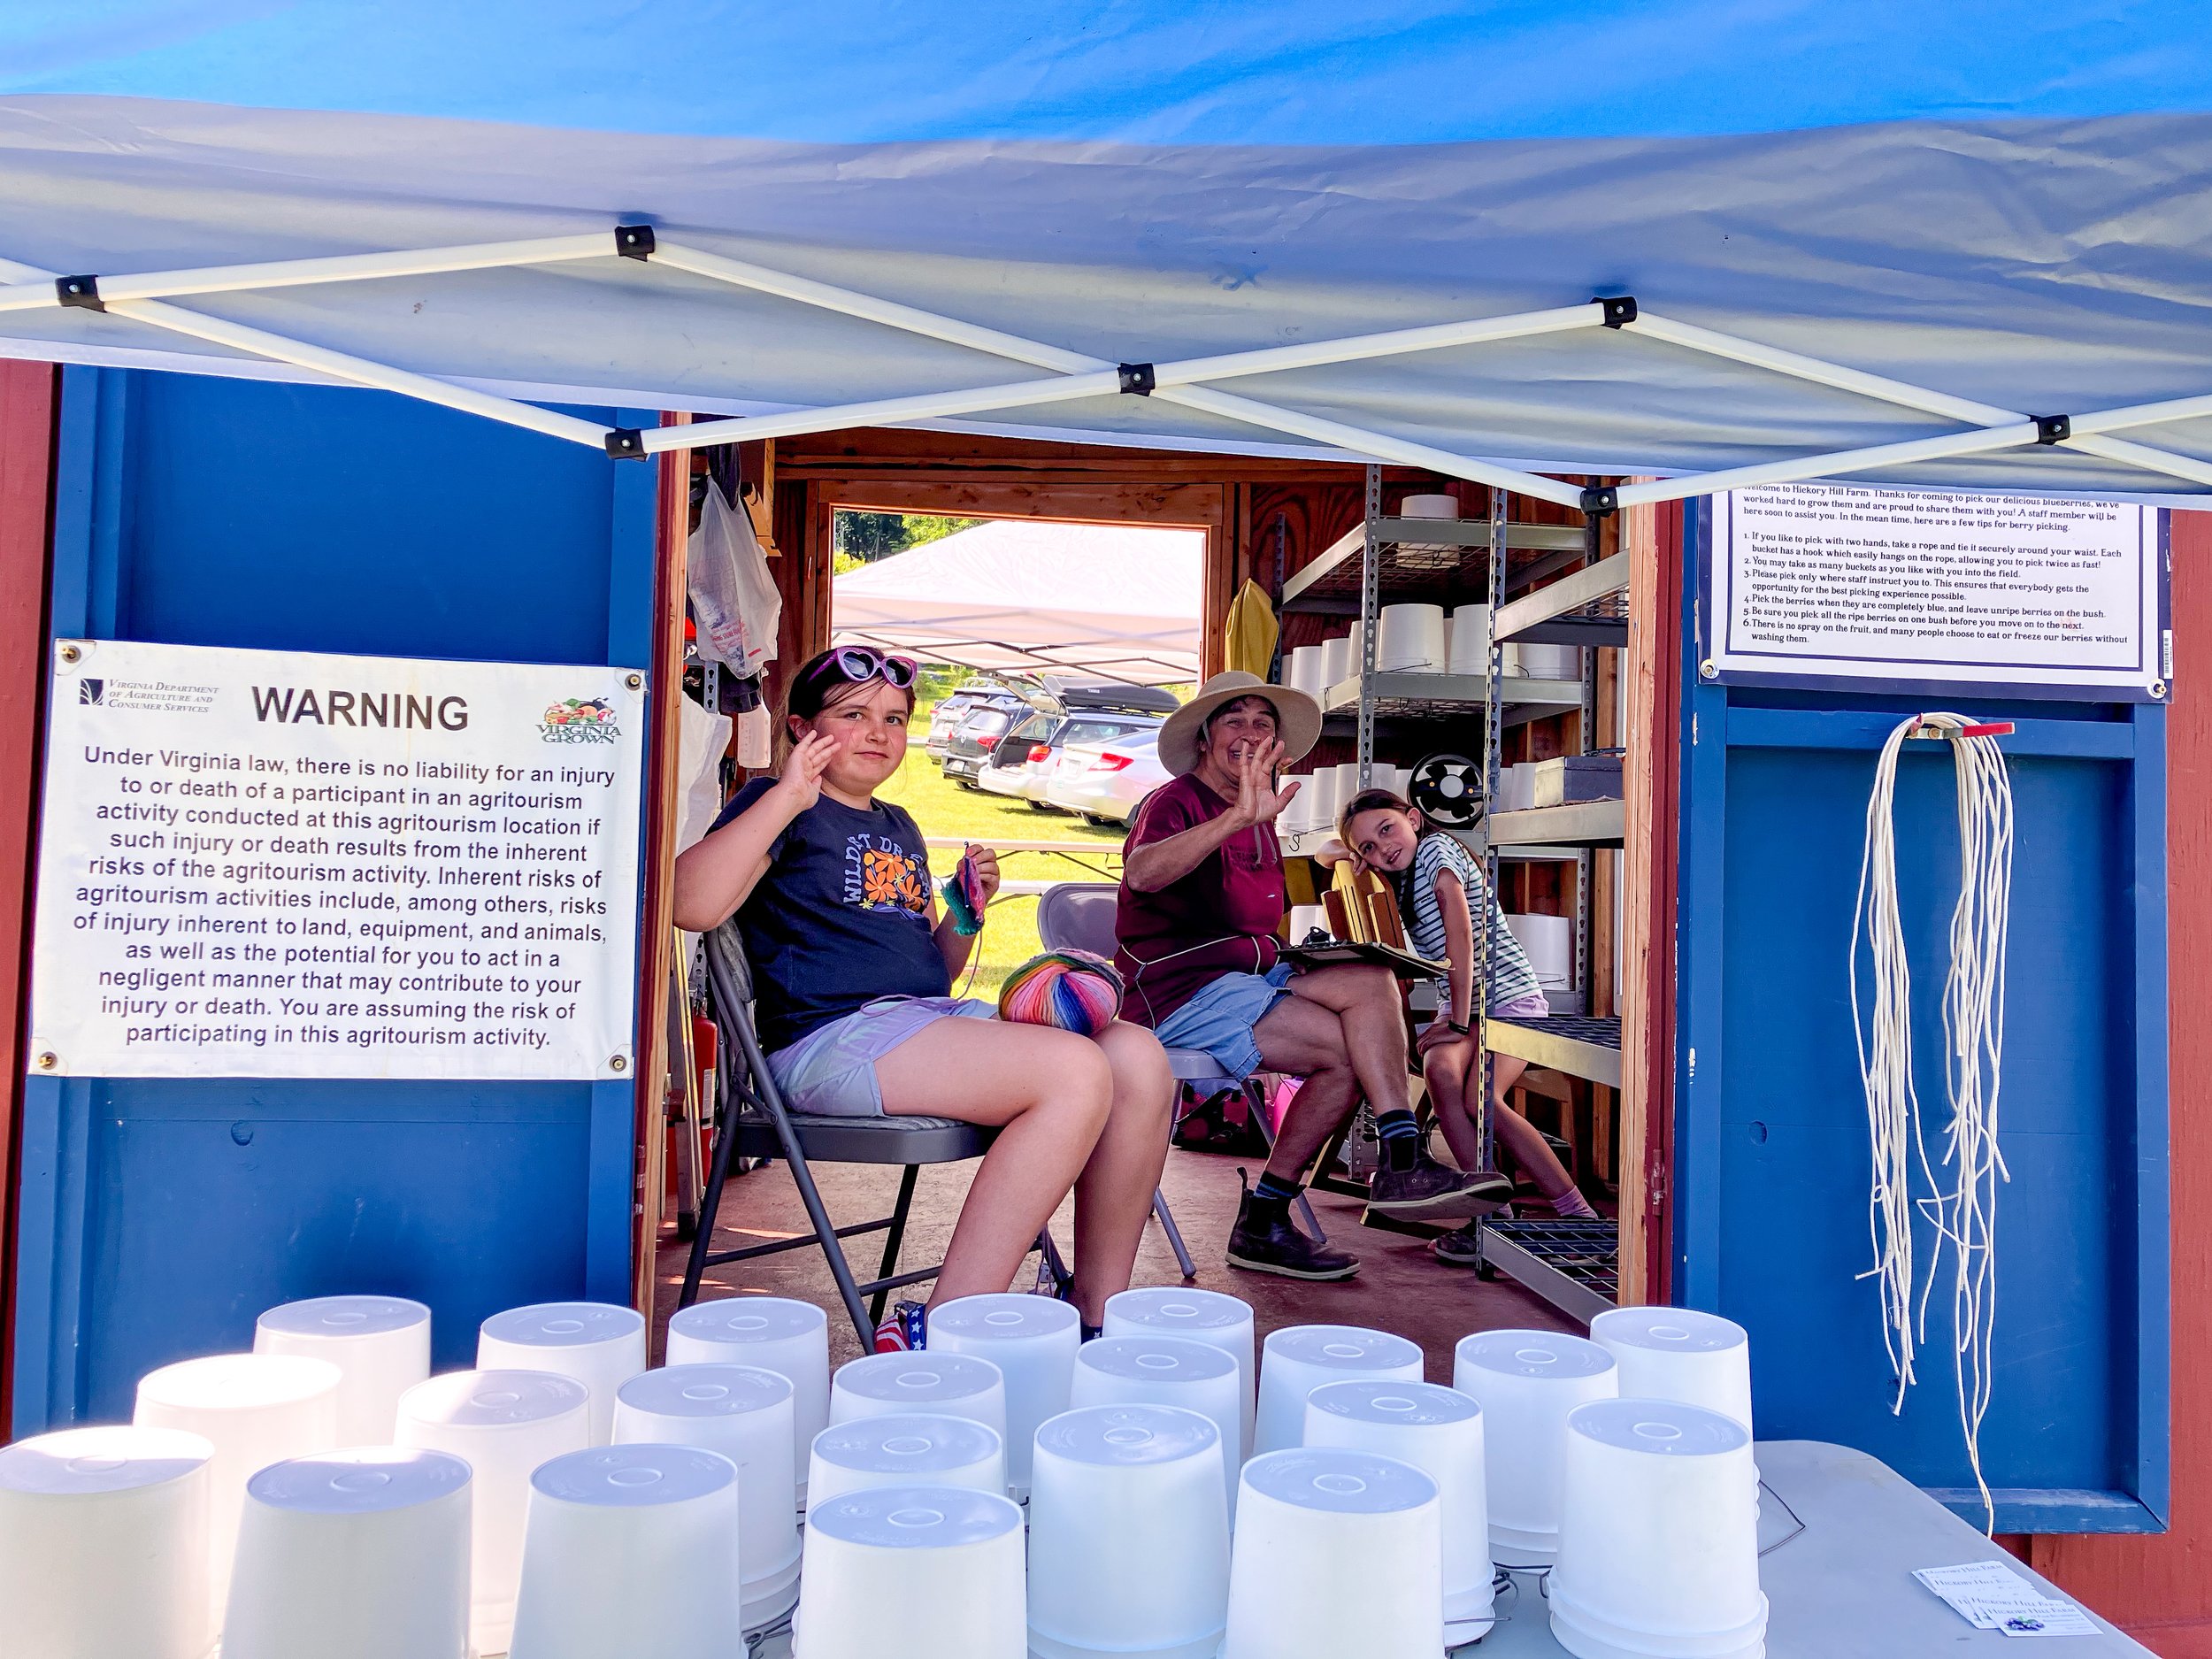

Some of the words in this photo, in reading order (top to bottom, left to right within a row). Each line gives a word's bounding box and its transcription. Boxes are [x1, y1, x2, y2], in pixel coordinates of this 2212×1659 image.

[1743, 506, 1763, 516] here
[1794, 511, 1817, 519] assist
[1839, 511, 1848, 520] In
[1850, 513, 1863, 522] the
[1891, 515, 1912, 525] time,
[1914, 516, 1934, 526] here
[1977, 519, 1993, 529] tips
[2009, 520, 2034, 532] berry
[2036, 522, 2070, 534] picking.
[1752, 556, 1768, 566] You
[1770, 559, 1787, 569] may
[1788, 559, 1807, 568] take
[1819, 563, 1844, 572] many
[1845, 562, 1877, 572] buckets
[1888, 566, 1906, 575] you
[1908, 565, 1924, 574] like
[1925, 566, 1945, 575] with
[1964, 568, 1982, 577] into
[1999, 569, 2021, 578] field.
[1752, 583, 1800, 595] opportunity
[1801, 585, 1814, 594] for
[1816, 586, 1830, 595] the
[1831, 586, 1847, 595] best
[1849, 588, 1880, 599] picking
[1882, 590, 1930, 599] experience
[1931, 592, 1967, 601] possible.
[1751, 633, 1785, 644] washing
[1786, 634, 1809, 643] them.
[109, 679, 153, 690] VIRGINIA
[156, 681, 219, 694] DEPARTMENT
[125, 690, 191, 702] AGRICULTURE
[108, 698, 162, 710] CONSUMER
[164, 703, 209, 713] SERVICES
[250, 685, 469, 732] WARNING
[535, 724, 622, 736] VIRGINIA
[541, 734, 615, 744] GROWN
[84, 745, 155, 766] Under
[158, 749, 242, 773] Virginia
[248, 754, 289, 776] law,
[296, 757, 351, 775] there
[358, 758, 376, 776] is
[383, 764, 409, 778] no
[416, 760, 490, 785] liability
[495, 764, 526, 781] for
[530, 769, 554, 782] an
[560, 765, 616, 788] injury
[119, 776, 142, 794] to
[149, 780, 173, 795] or
[179, 779, 238, 798] death
[245, 781, 268, 799] of
[273, 787, 285, 800] a
[292, 785, 406, 807] participant
[411, 787, 430, 805] in
[436, 792, 462, 806] an
[468, 790, 583, 811] agritourism
[96, 802, 180, 827] activity
[185, 807, 299, 827] conducted
[305, 810, 326, 828] at
[332, 810, 373, 829] this
[377, 813, 496, 835] agritourism
[503, 816, 581, 835] location
[588, 818, 602, 836] if
[109, 830, 165, 849] such
[173, 831, 234, 856] injury
[240, 838, 265, 853] or
[269, 835, 329, 855] death
[336, 838, 407, 857] results
[413, 839, 461, 859] from
[467, 841, 499, 860] the
[505, 842, 588, 862] inherent
[88, 855, 145, 876] risks
[152, 857, 177, 877] of
[181, 858, 216, 879] the
[222, 861, 346, 884] agritourism
[351, 864, 431, 889] activity.
[438, 865, 523, 887] Inherent
[527, 868, 576, 888] risks
[581, 870, 603, 889] of
[75, 884, 209, 907] agritourism
[215, 887, 312, 908] activities
[319, 890, 401, 914] include,
[407, 896, 478, 917] among
[484, 895, 554, 918] others,
[560, 895, 607, 915] risks
[73, 910, 98, 930] of
[104, 911, 171, 936] injury
[177, 913, 268, 934] inherent
[275, 917, 297, 935] to
[302, 917, 352, 940] land,
[359, 919, 473, 942] equipment,
[480, 921, 518, 940] and
[524, 922, 607, 945] animals,
[125, 944, 152, 959] as
[159, 941, 204, 960] well
[211, 946, 236, 961] as
[242, 942, 277, 962] the
[284, 945, 376, 966] potential
[381, 945, 412, 964] for
[417, 951, 454, 970] you
[460, 948, 481, 966] to
[488, 949, 519, 967] act
[525, 949, 542, 967] in
[549, 953, 560, 968] a
[98, 967, 206, 992] negligent
[211, 973, 296, 989] manner
[301, 971, 343, 990] that
[349, 976, 393, 995] may
[398, 973, 503, 993] contribute
[509, 975, 530, 993] to
[535, 979, 582, 998] your
[101, 995, 168, 1019] injury
[174, 1001, 199, 1015] or
[204, 996, 272, 1016] death.
[279, 997, 319, 1016] You
[326, 1002, 359, 1017] are
[365, 1000, 466, 1023] assuming
[472, 1001, 505, 1019] the
[511, 1002, 549, 1019] risk
[555, 1002, 577, 1020] of
[126, 1023, 267, 1048] participating
[273, 1024, 293, 1043] in
[300, 1025, 340, 1043] this
[346, 1025, 466, 1048] agritourism
[472, 1027, 550, 1050] activity.
